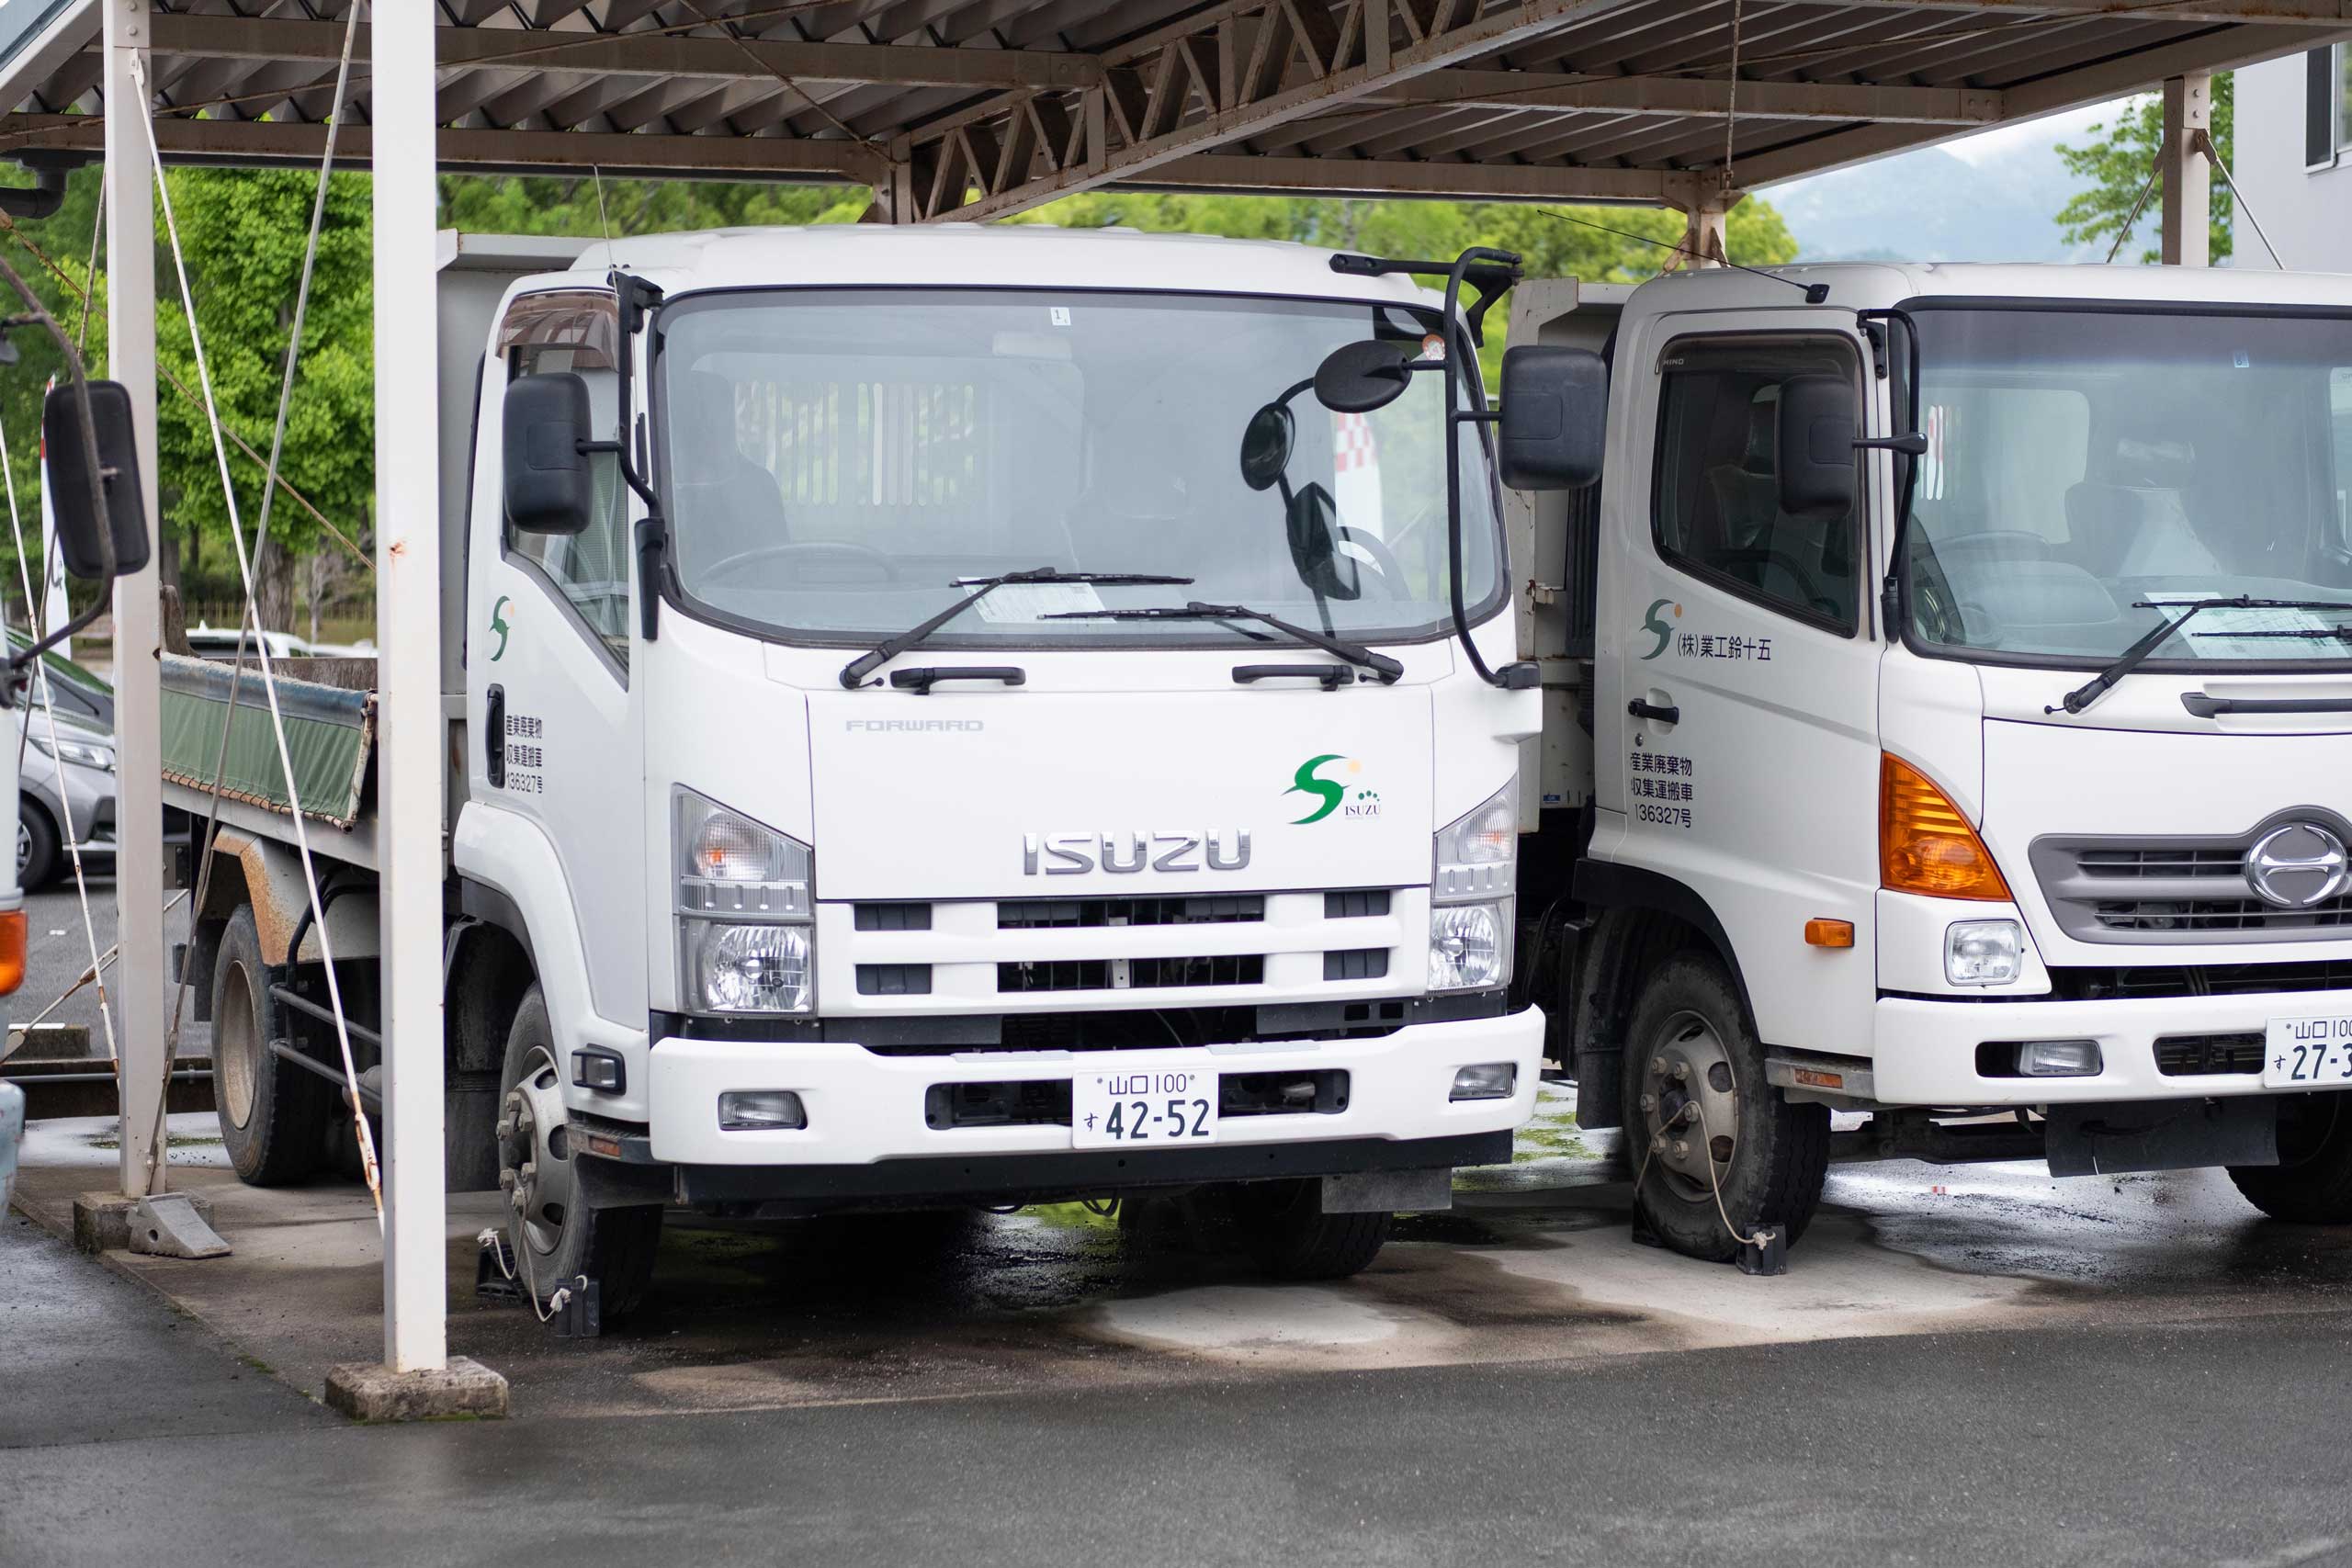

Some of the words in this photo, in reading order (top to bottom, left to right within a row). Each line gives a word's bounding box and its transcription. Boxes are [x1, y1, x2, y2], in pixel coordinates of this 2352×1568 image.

[845, 719, 984, 732] FORWARD
[1630, 752, 1692, 776] 産業廃棄物
[506, 772, 543, 794] 136327号
[1345, 804, 1382, 816] ISUZU
[1634, 804, 1692, 829] 136327号
[1023, 829, 1251, 875] ISUZU
[1105, 1099, 1210, 1140] 42-52
